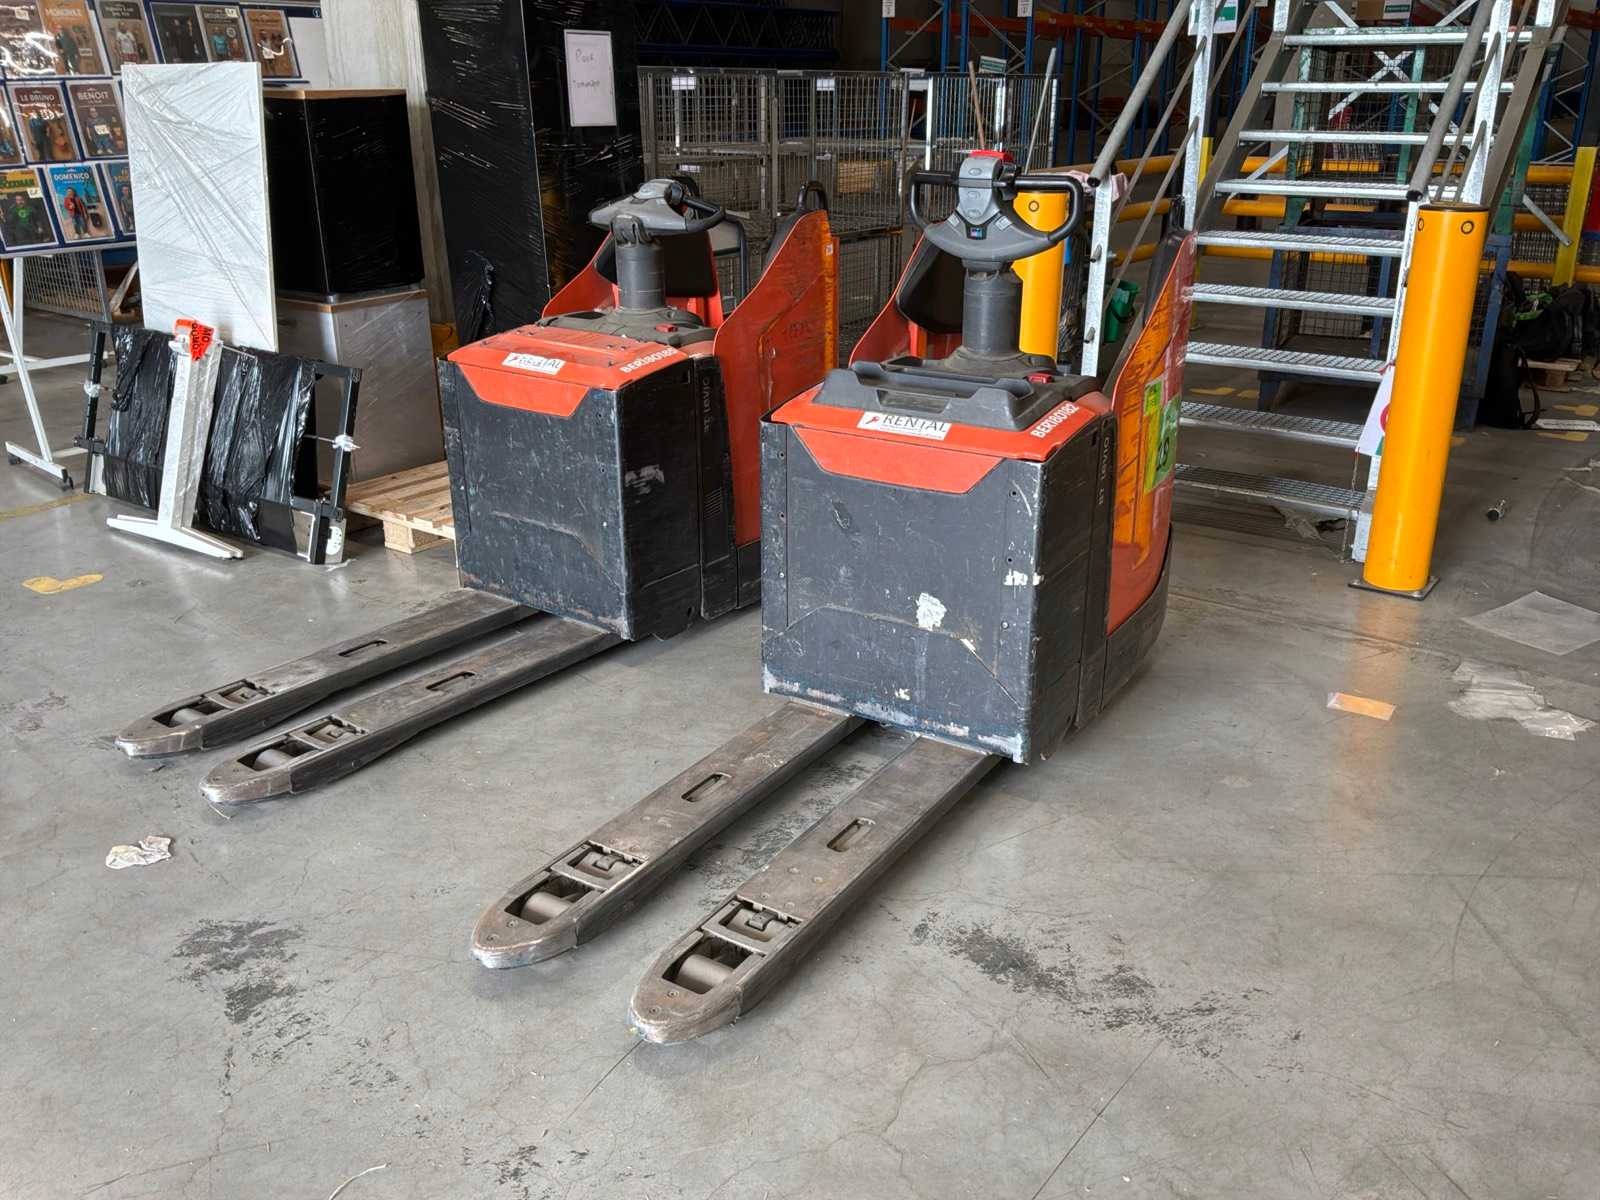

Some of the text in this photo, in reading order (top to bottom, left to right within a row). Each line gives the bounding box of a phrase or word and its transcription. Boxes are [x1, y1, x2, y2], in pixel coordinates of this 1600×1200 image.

[78, 91, 109, 100] BENOIT
[54, 173, 90, 181] DOMENICO
[883, 414, 946, 432] RENTAL
